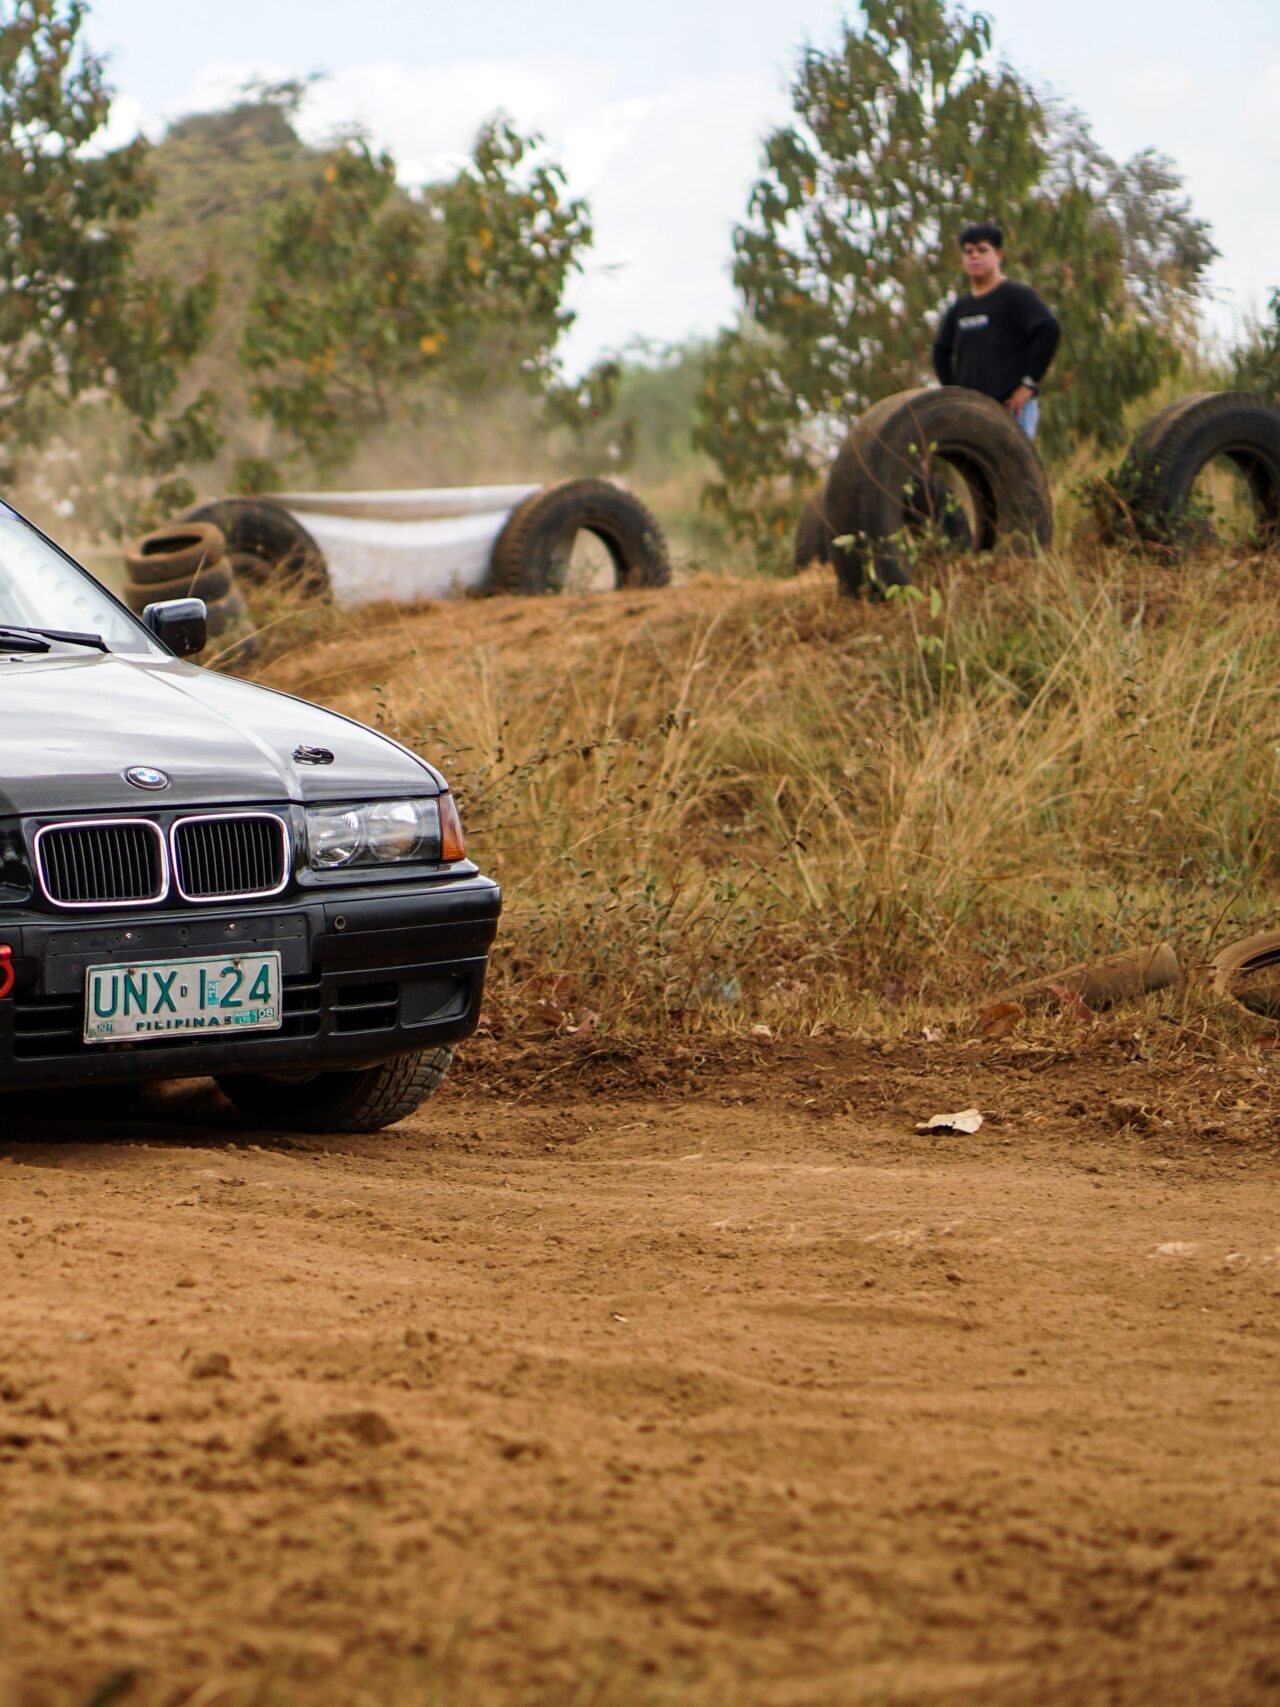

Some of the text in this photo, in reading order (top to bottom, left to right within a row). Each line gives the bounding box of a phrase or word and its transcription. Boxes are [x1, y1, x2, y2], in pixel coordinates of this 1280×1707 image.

[94, 962, 271, 1017] UNX 124
[258, 1008, 273, 1018] 08
[136, 1015, 233, 1031] PILIPINAS
